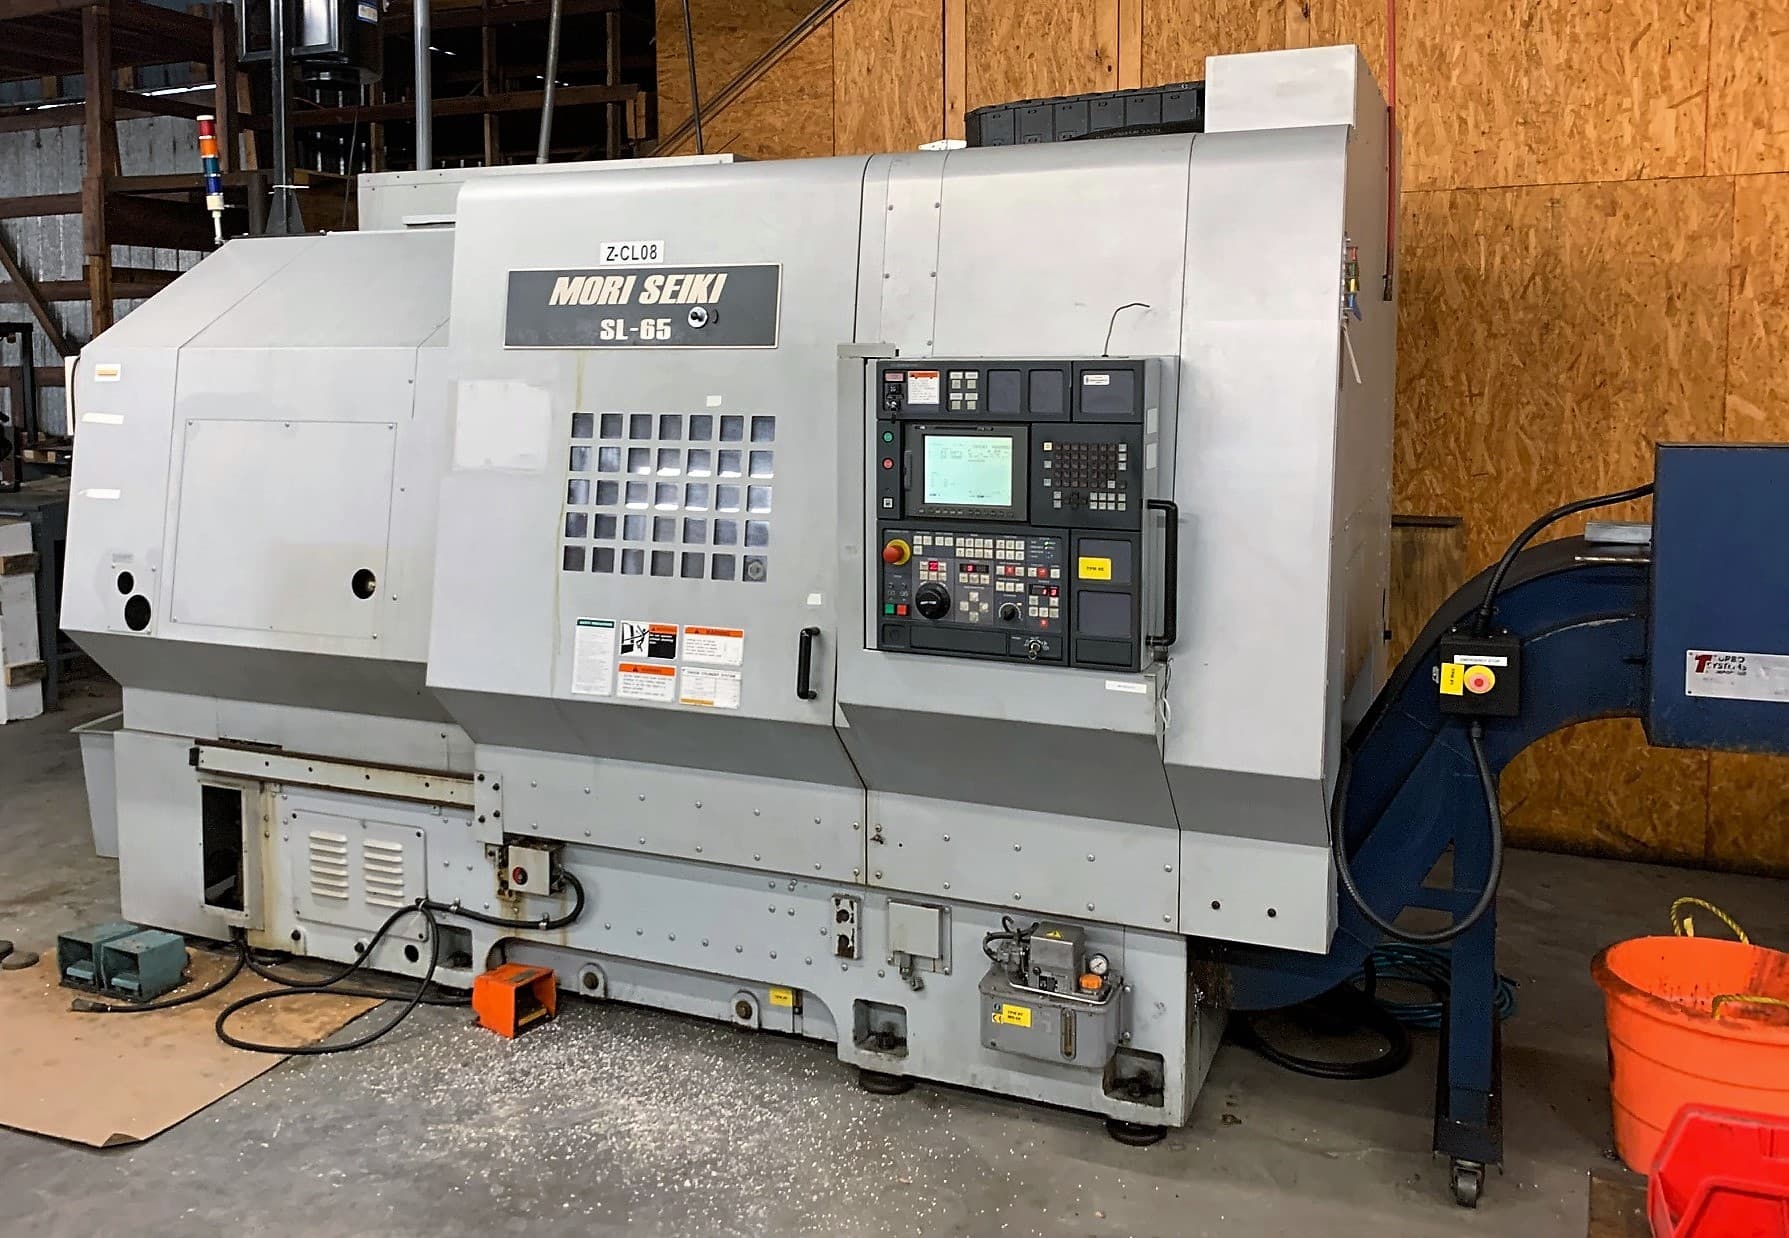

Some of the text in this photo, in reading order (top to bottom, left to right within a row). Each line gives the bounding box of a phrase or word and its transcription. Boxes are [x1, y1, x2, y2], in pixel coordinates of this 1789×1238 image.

[606, 244, 658, 261] Z-CL08
[549, 273, 728, 306] MORI SEIKI
[600, 318, 672, 341] SL-65
